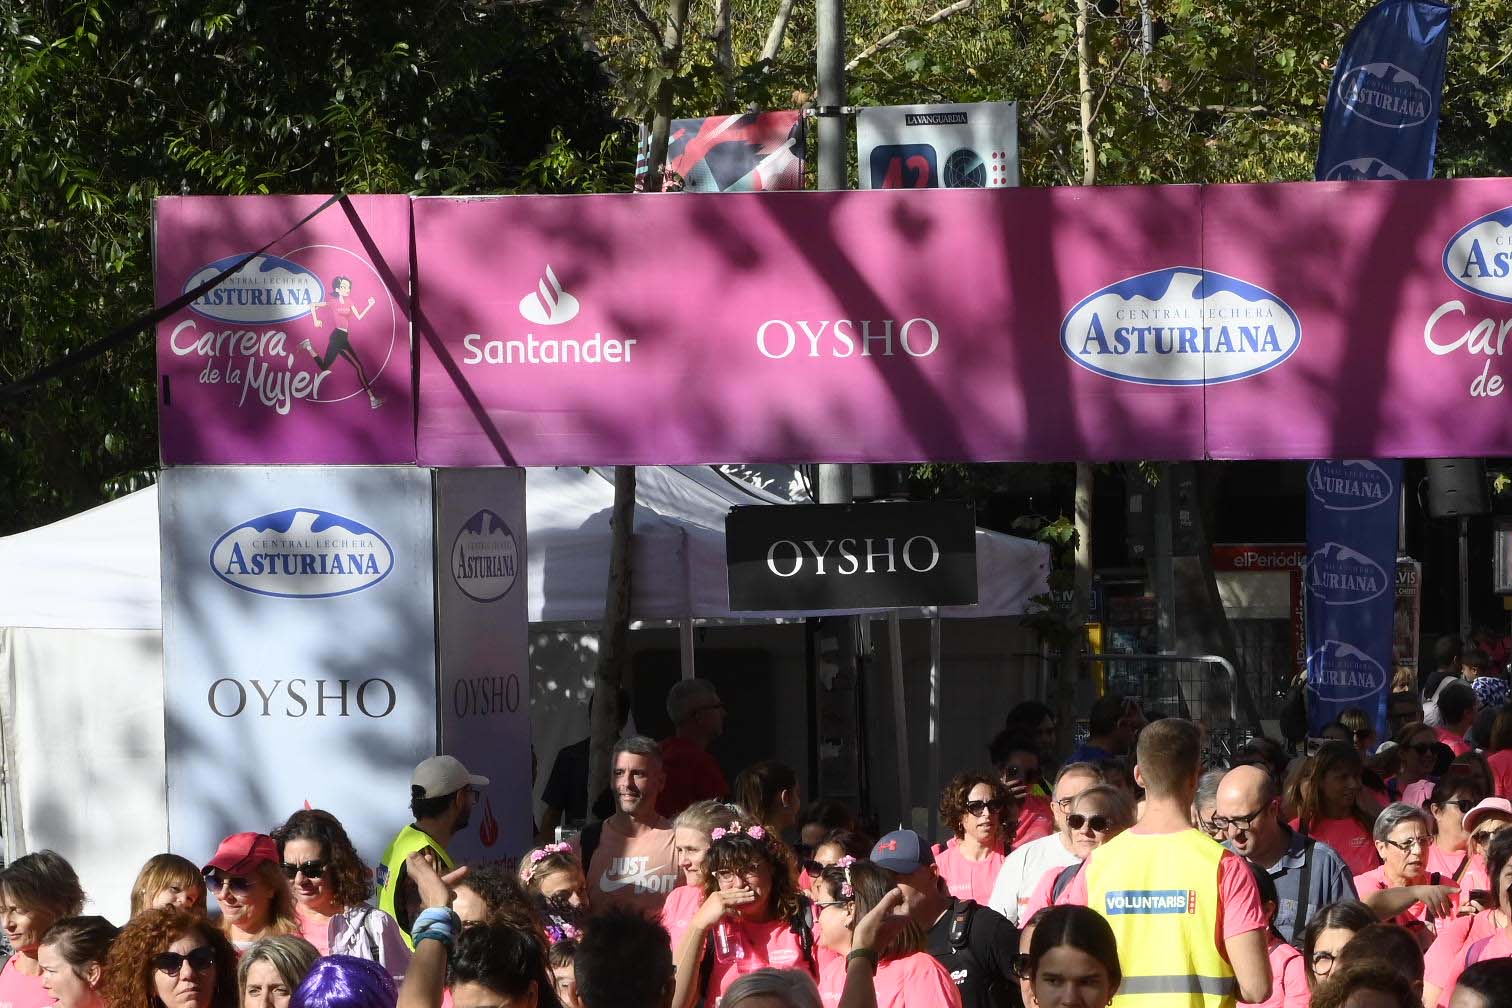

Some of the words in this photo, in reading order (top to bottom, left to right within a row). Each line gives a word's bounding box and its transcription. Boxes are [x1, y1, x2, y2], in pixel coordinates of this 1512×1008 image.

[1116, 309, 1192, 321] CENTRAL
[170, 320, 288, 355] Carrera
[463, 332, 637, 365] Santander
[756, 318, 940, 359] OYSHO
[1079, 312, 1283, 355] ASTURIANA
[200, 358, 221, 384] de
[225, 358, 241, 384] la
[239, 353, 332, 415] Mujer
[1470, 358, 1504, 397] de
[224, 542, 380, 576] ASTURIANA
[252, 539, 311, 549] CENTRAL
[316, 538, 374, 549] LECHERA
[766, 535, 940, 578] OYSHO
[457, 545, 516, 580] ASTURIANA
[207, 677, 397, 719] OYSHO
[454, 672, 520, 720] OYSHO
[607, 855, 650, 876] JUST
[1107, 895, 1186, 910] VOLUNTARIS
